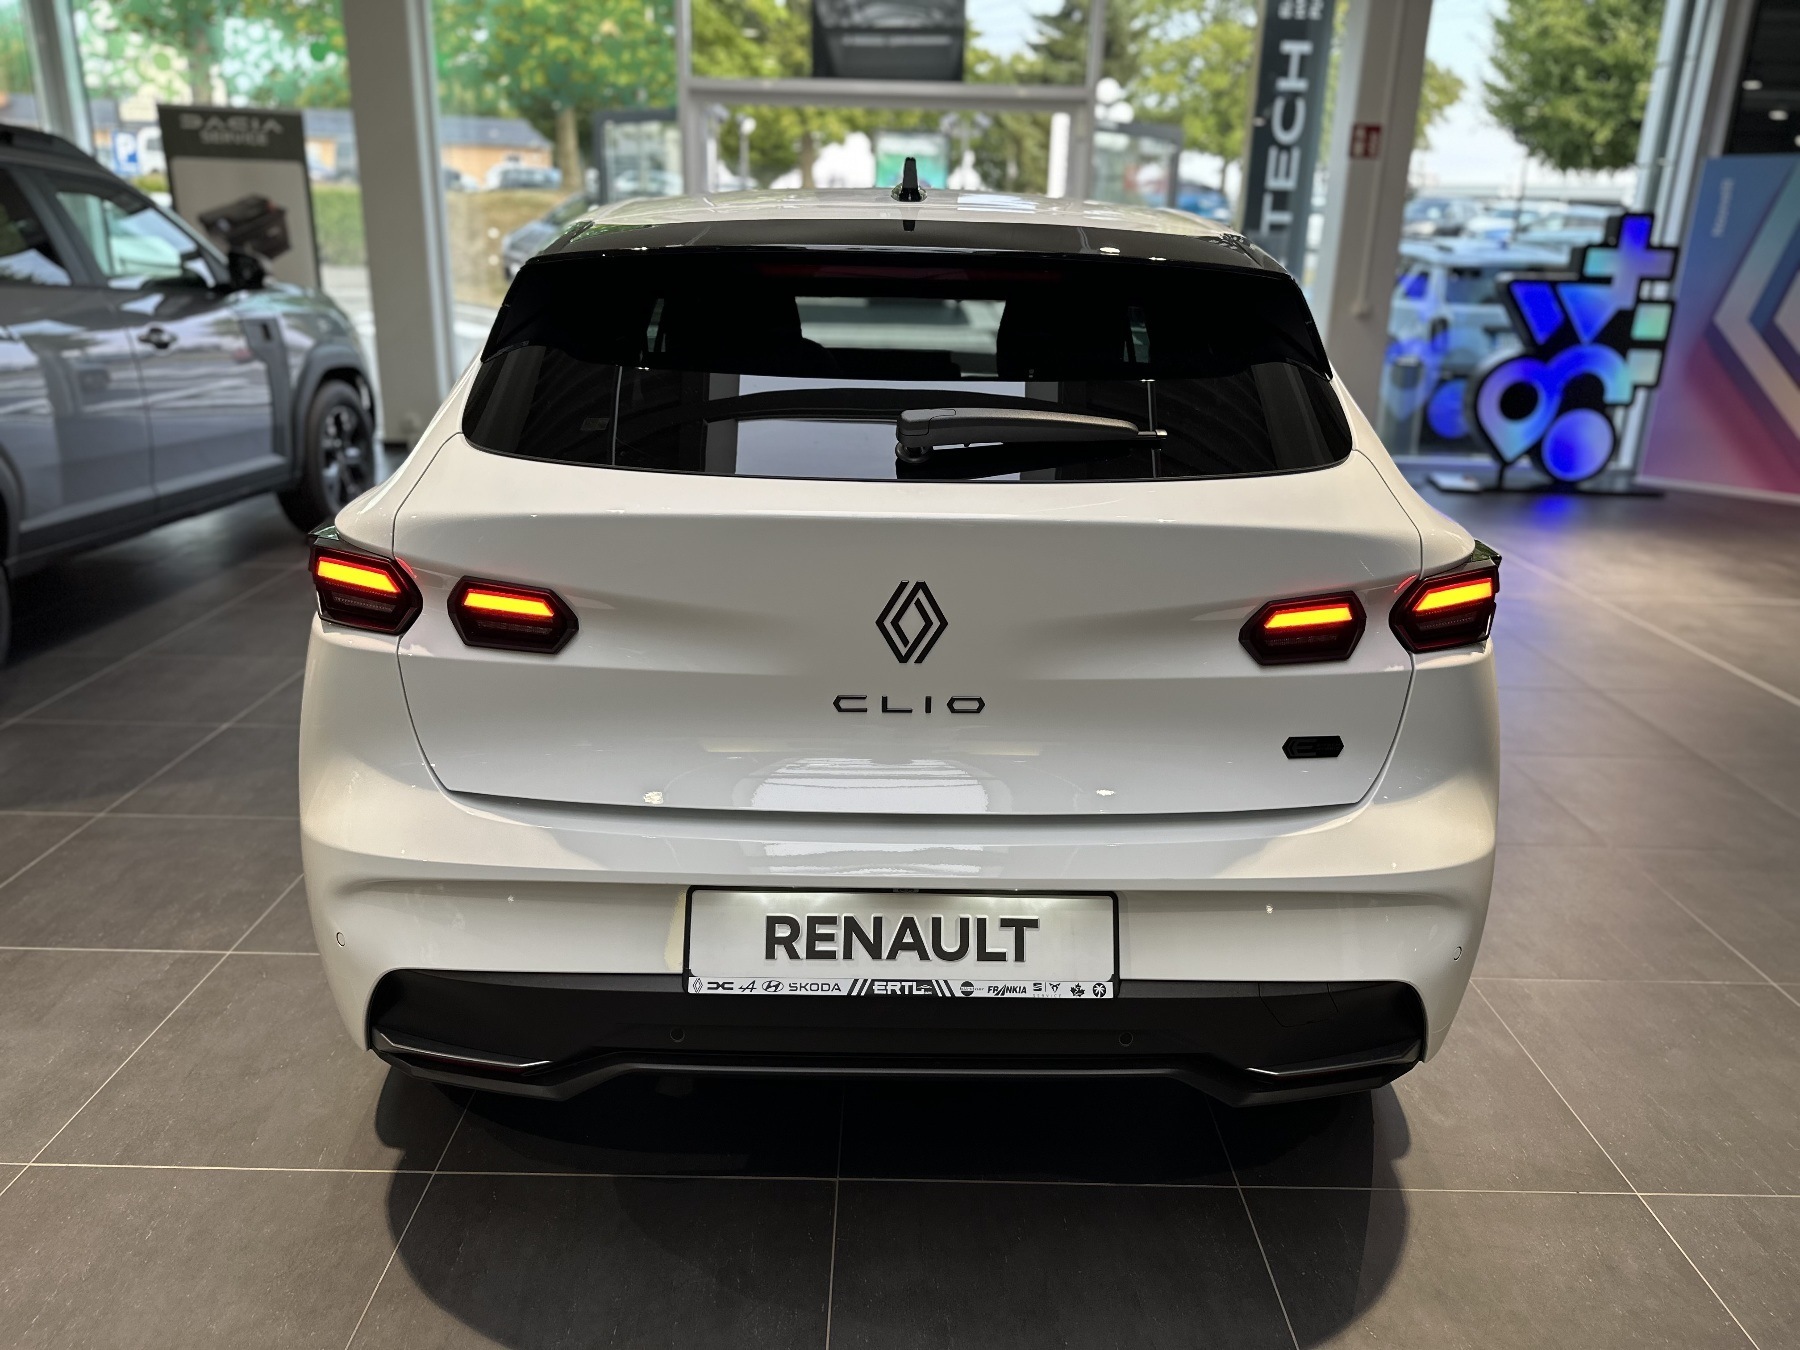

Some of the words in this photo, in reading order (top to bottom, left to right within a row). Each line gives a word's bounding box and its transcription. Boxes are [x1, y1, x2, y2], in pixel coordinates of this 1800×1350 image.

[1260, 39, 1314, 237] TECH
[832, 694, 986, 714] CLIO
[764, 914, 1039, 963] RENAULT
[987, 984, 1027, 996] FRANKIA
